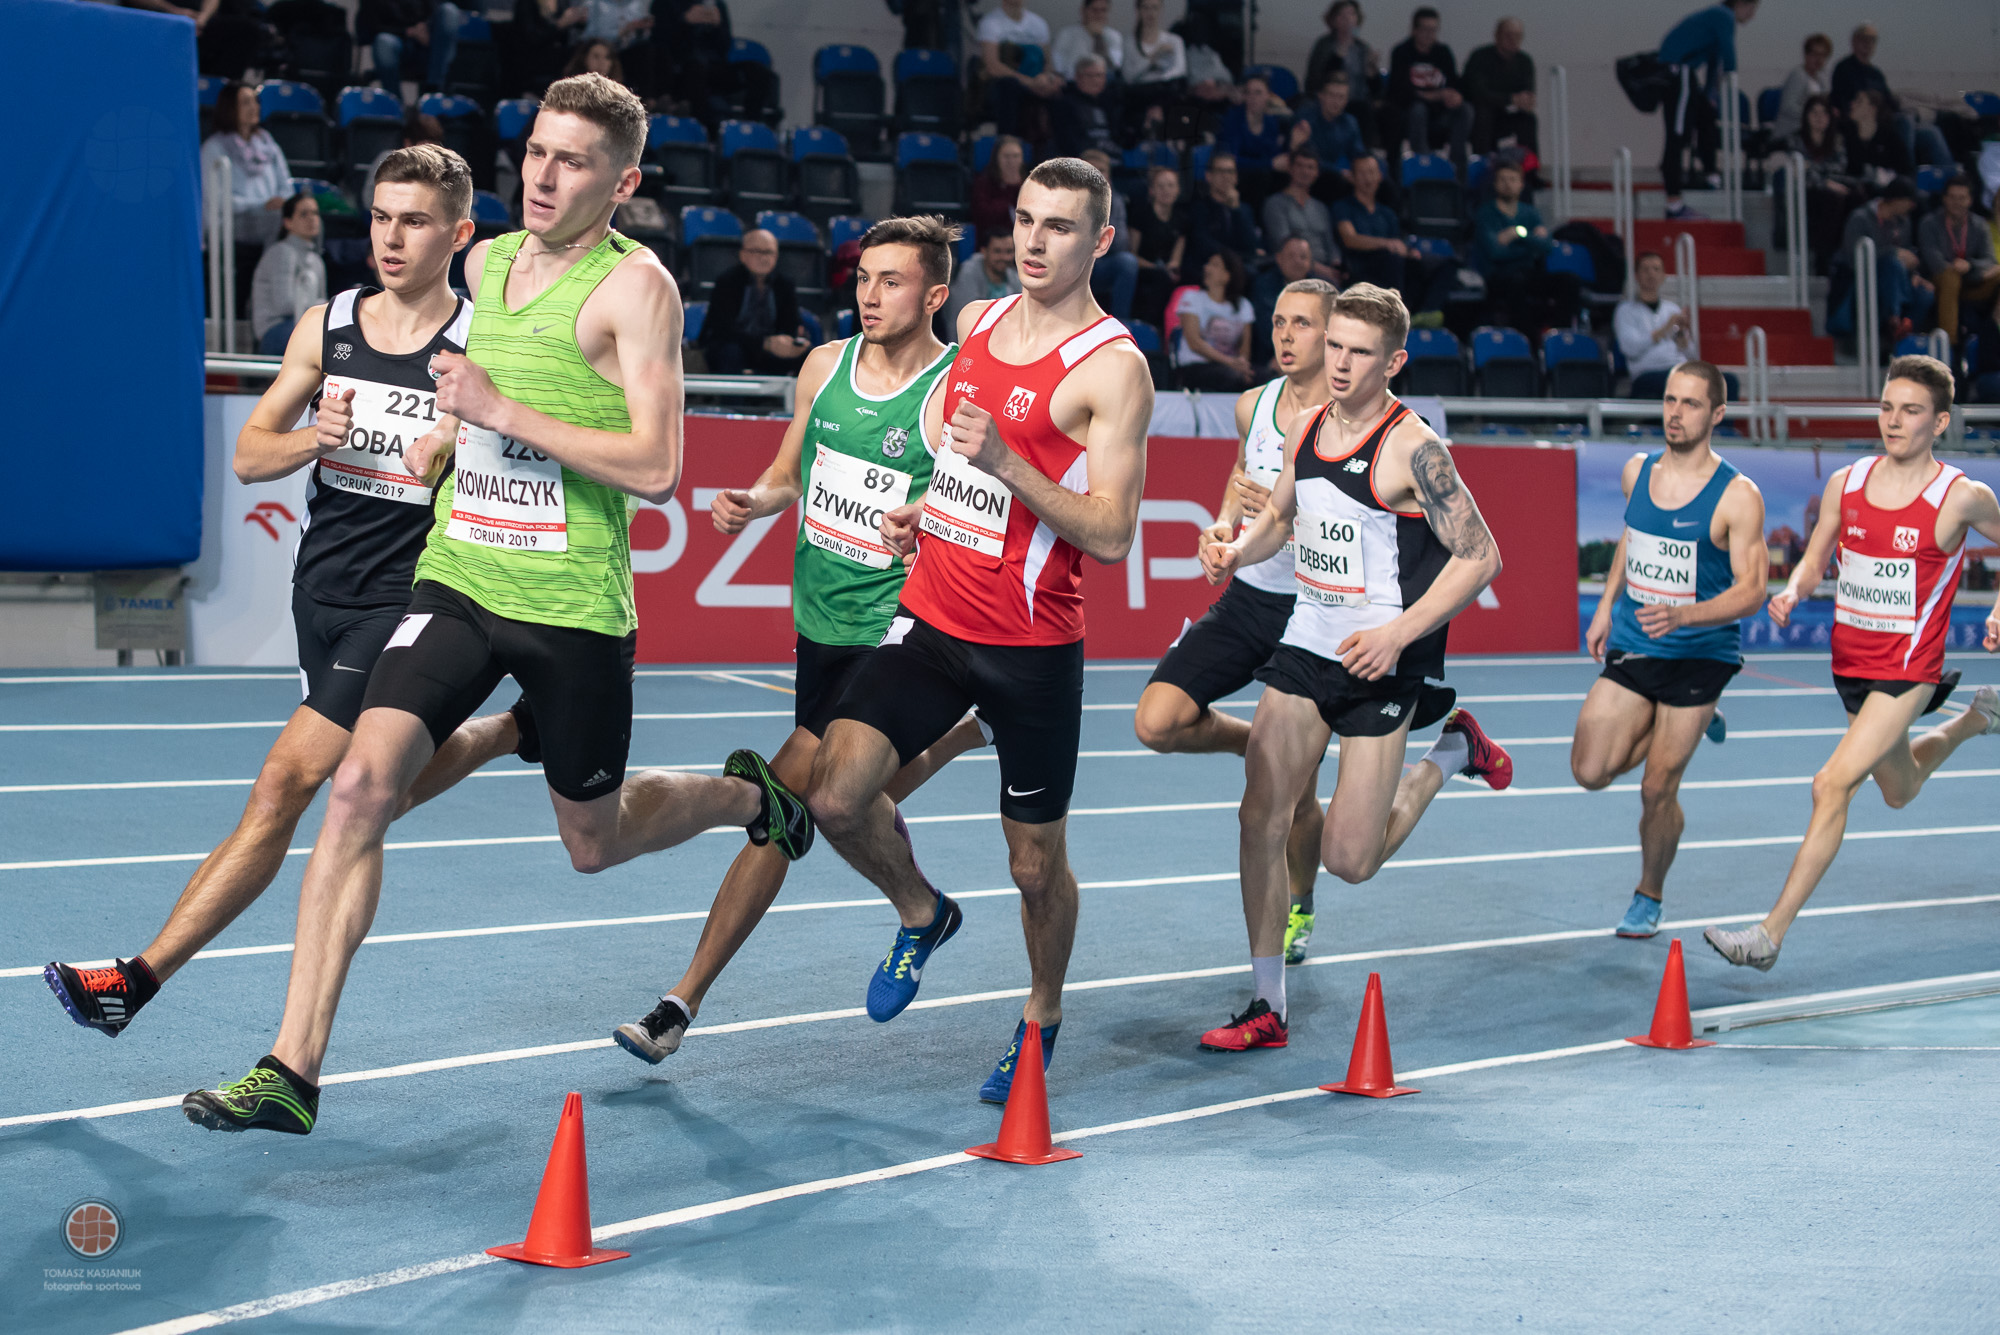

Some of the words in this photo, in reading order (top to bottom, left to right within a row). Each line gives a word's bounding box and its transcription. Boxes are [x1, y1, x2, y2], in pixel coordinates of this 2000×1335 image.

[385, 391, 436, 421] 221
[823, 421, 840, 431] UMCS
[336, 475, 372, 492] TORUŃ
[375, 483, 404, 498] 2019
[457, 468, 559, 506] KOWALCZYK
[864, 468, 895, 493] 89
[930, 469, 1005, 518] MARMON
[494, 520, 535, 530] MISTRZOSTWA
[924, 517, 951, 538] TORUŃ
[954, 531, 979, 547] 2019
[1320, 521, 1354, 542] 160
[469, 527, 504, 544] TORUŃ
[509, 534, 538, 547] 2019
[813, 533, 842, 552] TORUŃ
[844, 545, 868, 562] 2019
[1299, 545, 1348, 574] DĘBSKI
[1658, 541, 1691, 559] 300
[1627, 555, 1689, 584] KACZAN
[1874, 562, 1910, 578] 209
[1324, 592, 1344, 603] 2019
[1839, 581, 1911, 606] NOWAKOWSKI
[1876, 621, 1896, 629] 2019
[582, 774, 612, 788] adidas
